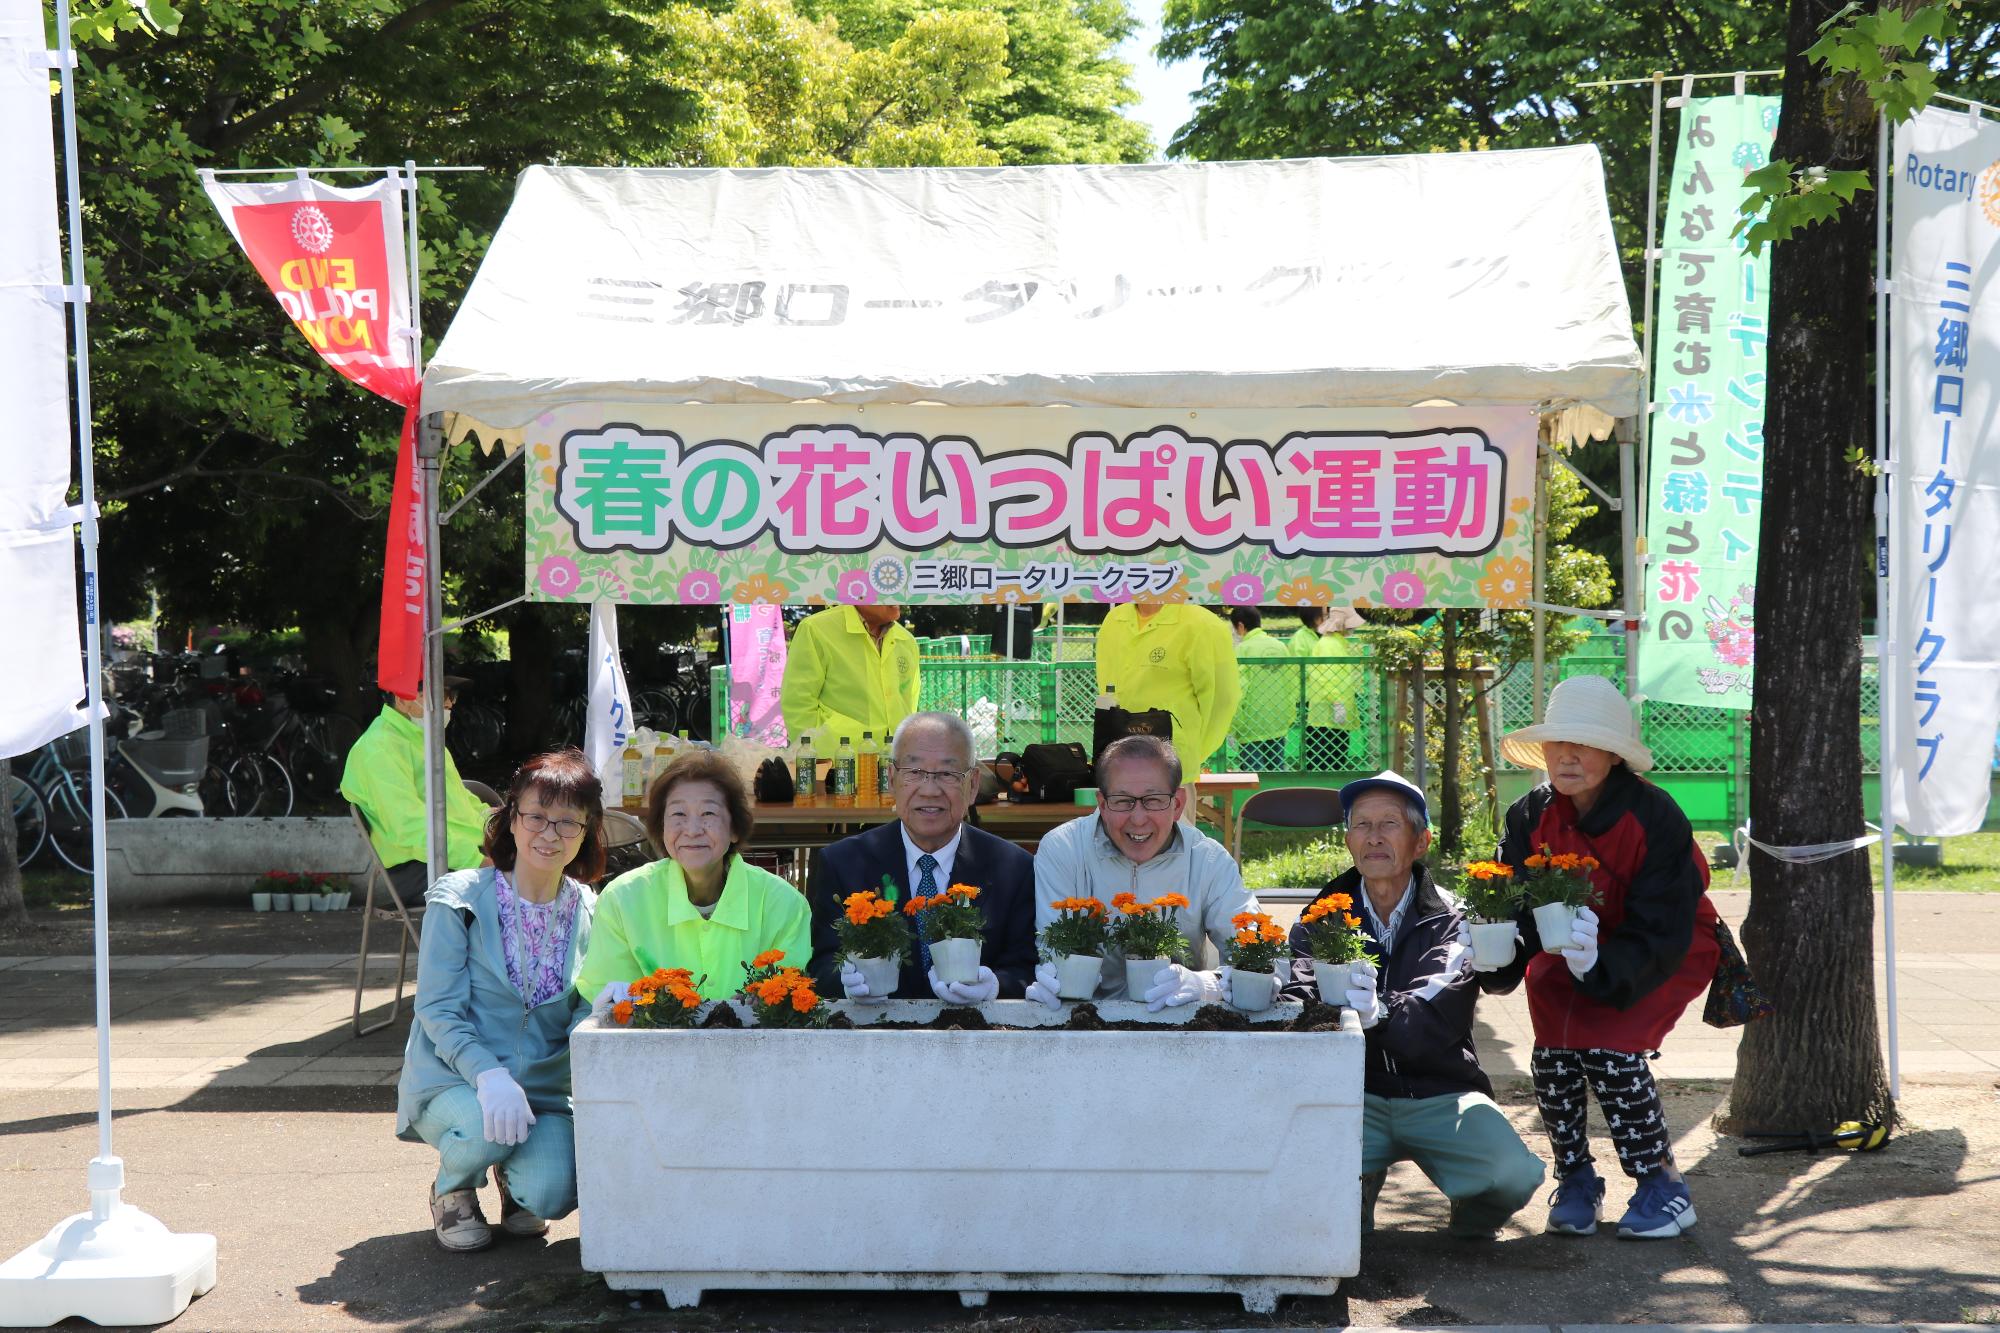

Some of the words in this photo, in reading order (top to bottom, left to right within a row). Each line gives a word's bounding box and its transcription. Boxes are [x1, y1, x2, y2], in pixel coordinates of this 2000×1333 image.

[1906, 153, 1976, 202] Rotary
[573, 440, 1489, 541] 春の花いっぱい運動
[1914, 261, 1971, 782] 三郷ロータリークラブ
[913, 564, 1176, 591] 三郷ロータリークラブ
